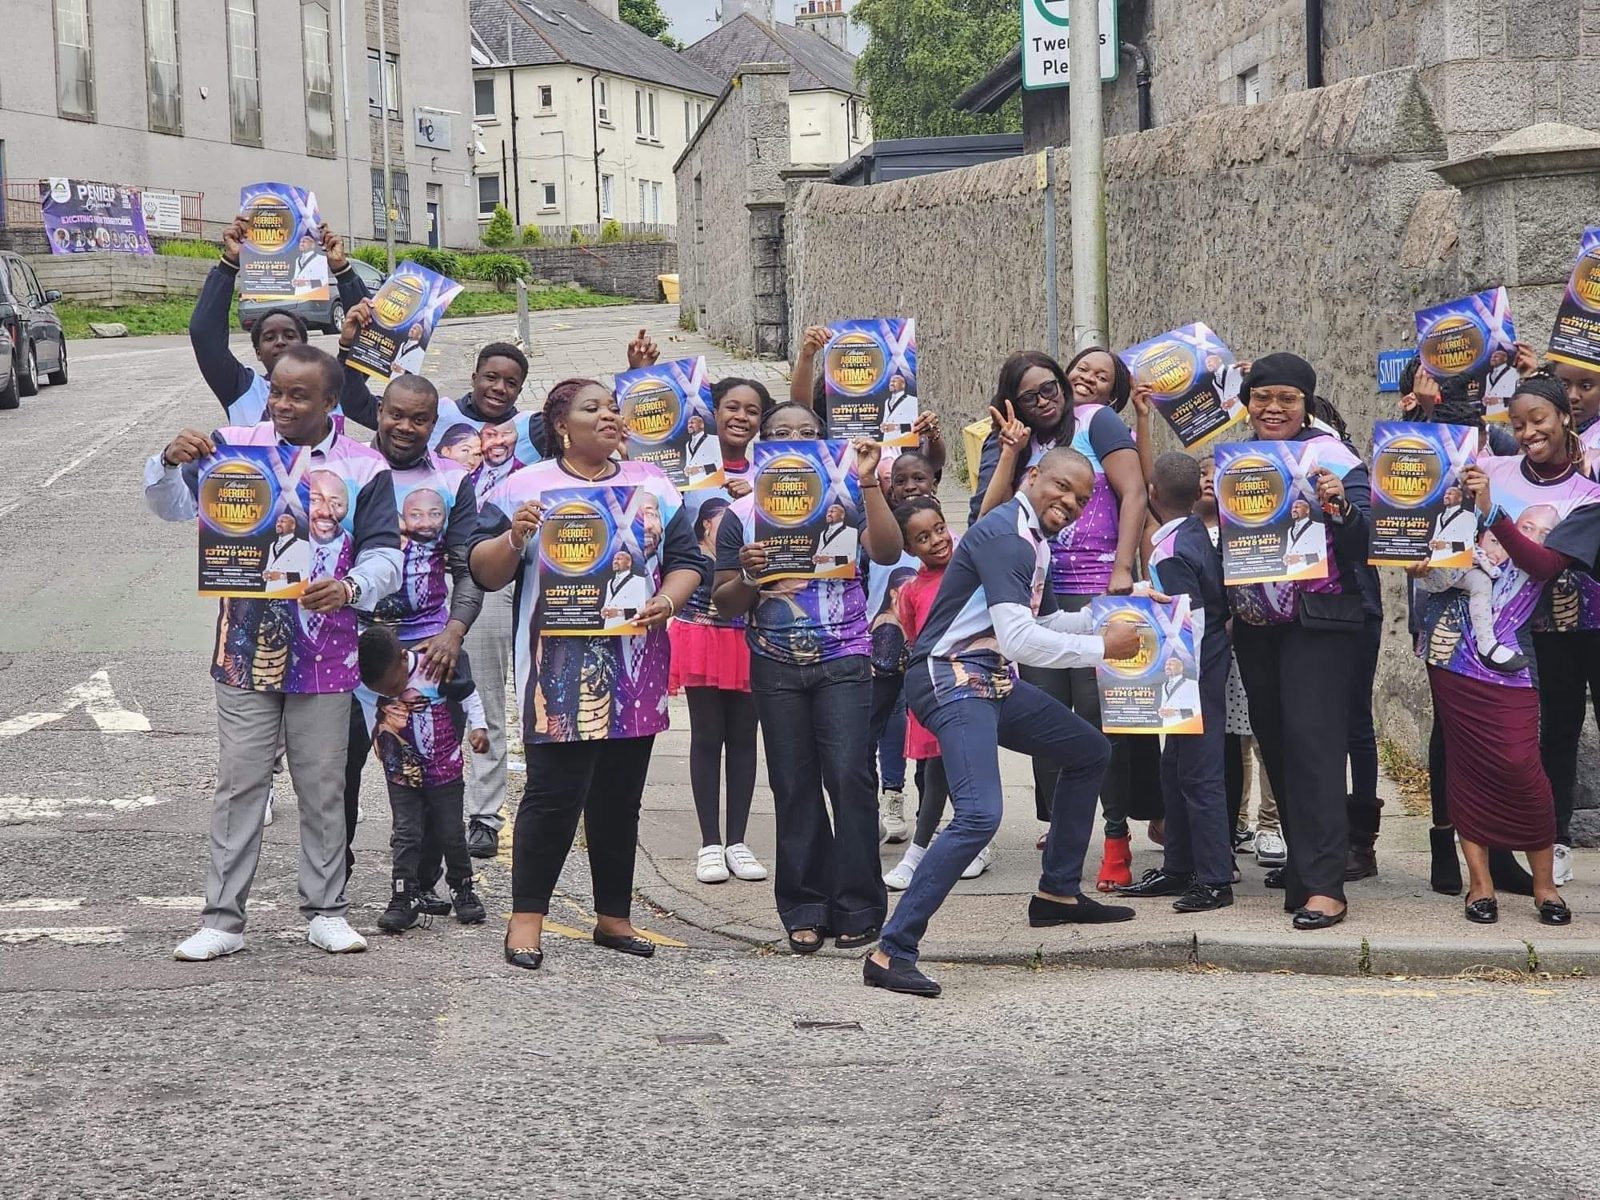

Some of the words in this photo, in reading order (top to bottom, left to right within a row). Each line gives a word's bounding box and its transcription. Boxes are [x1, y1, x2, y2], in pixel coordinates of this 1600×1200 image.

[1032, 33, 1106, 52] Twes
[1043, 59, 1069, 76] Ple
[253, 216, 283, 225] ABERDEEN
[840, 355, 872, 364] ABERDEEN
[1430, 349, 1478, 366] INTIMACY
[833, 368, 878, 381] INTIMACY
[634, 400, 667, 413] ABERDEEN
[629, 412, 675, 431] INTIMACY
[1390, 462, 1426, 472] ABERDEEN
[772, 482, 807, 491] ABERDEEN
[1235, 481, 1270, 491] ABERDEEN
[1382, 476, 1432, 492] INTIMACY
[217, 488, 256, 498] ABERDEEN
[763, 496, 814, 511] INTIMACY
[1228, 494, 1278, 511] INTIMACY
[209, 503, 263, 518] INTIMACY
[557, 528, 593, 538] ABERDEEN
[1227, 539, 1252, 547] 13TH
[1258, 537, 1281, 545] 14TH
[237, 550, 263, 558] 14TH
[549, 543, 600, 558] INTIMACY
[576, 588, 600, 596] 14TH
